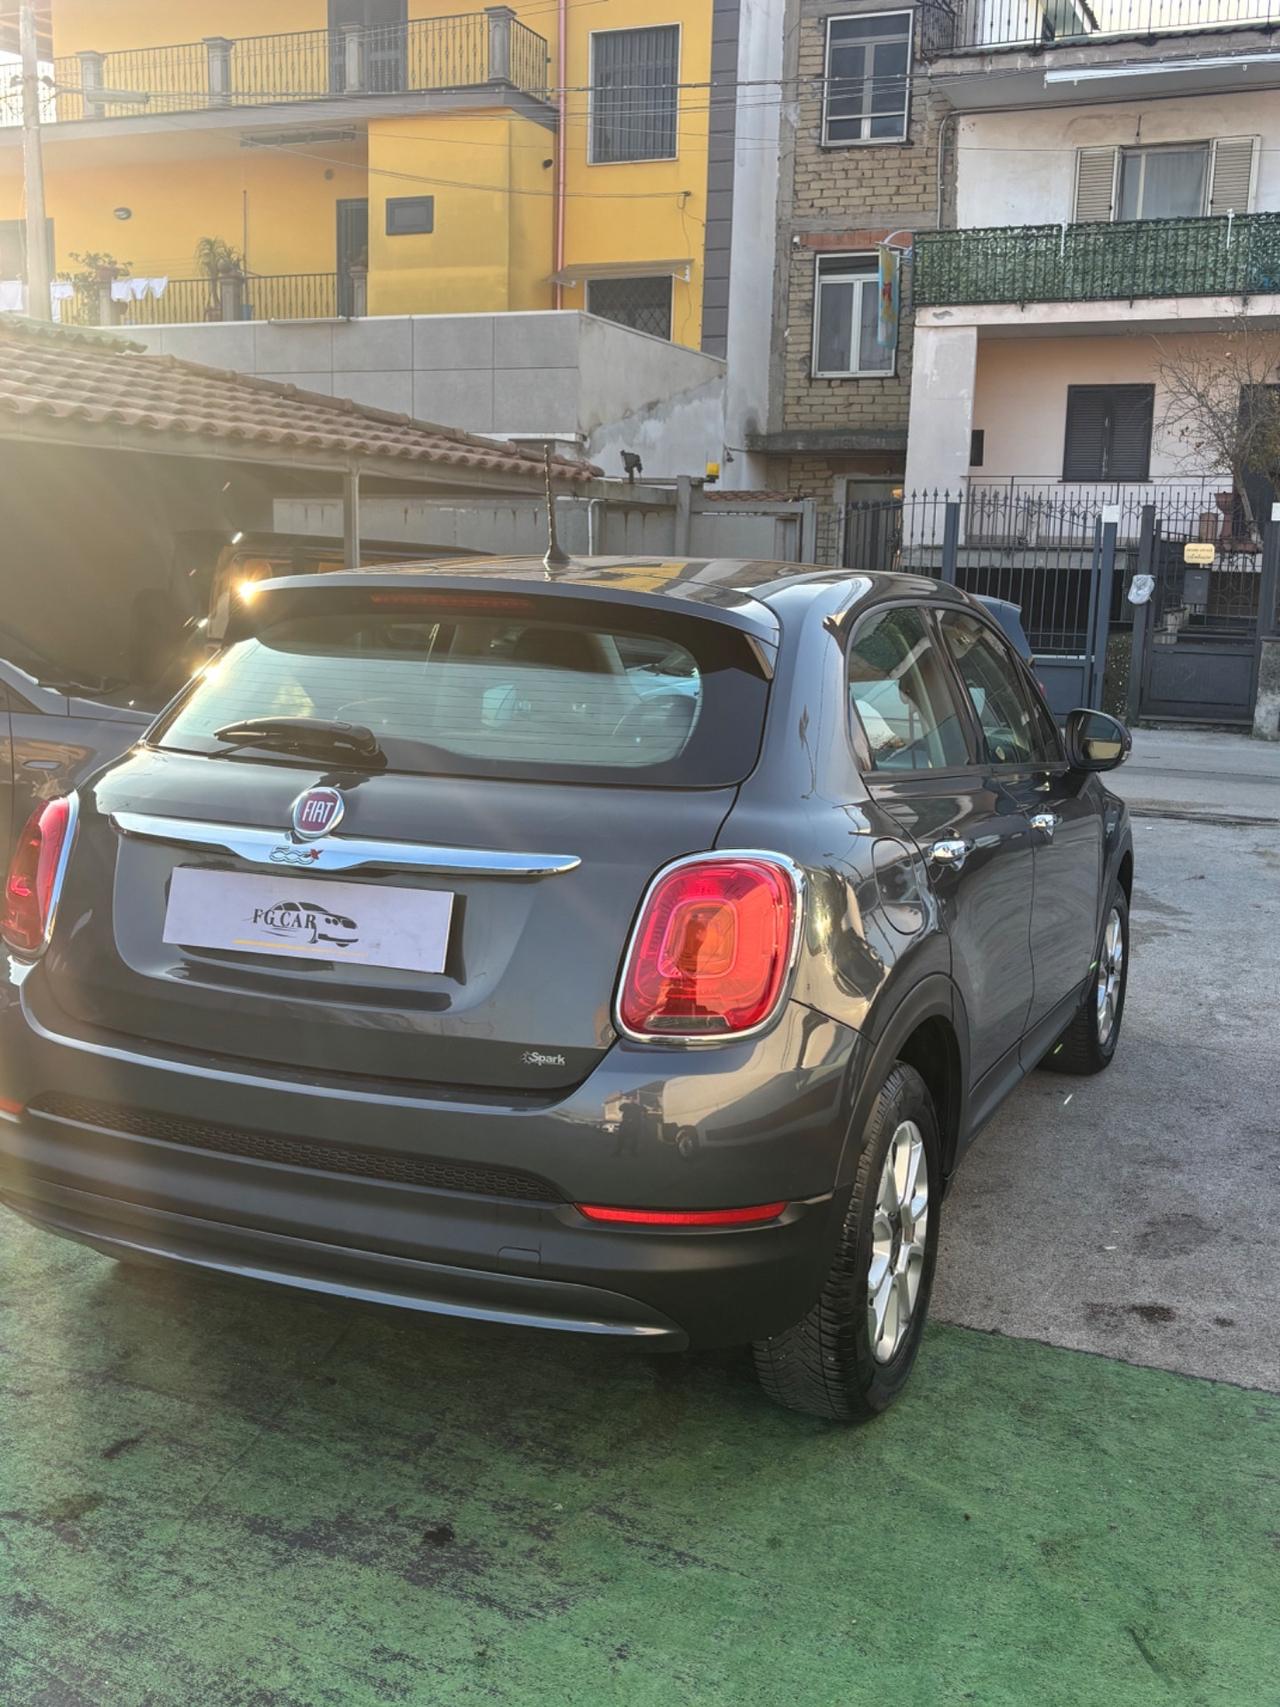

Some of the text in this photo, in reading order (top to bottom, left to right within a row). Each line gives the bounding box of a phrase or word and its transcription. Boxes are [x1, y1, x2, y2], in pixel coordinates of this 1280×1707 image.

[302, 800, 335, 823] FIAT
[252, 908, 318, 943] FG CAR
[528, 1051, 566, 1066] Spark
